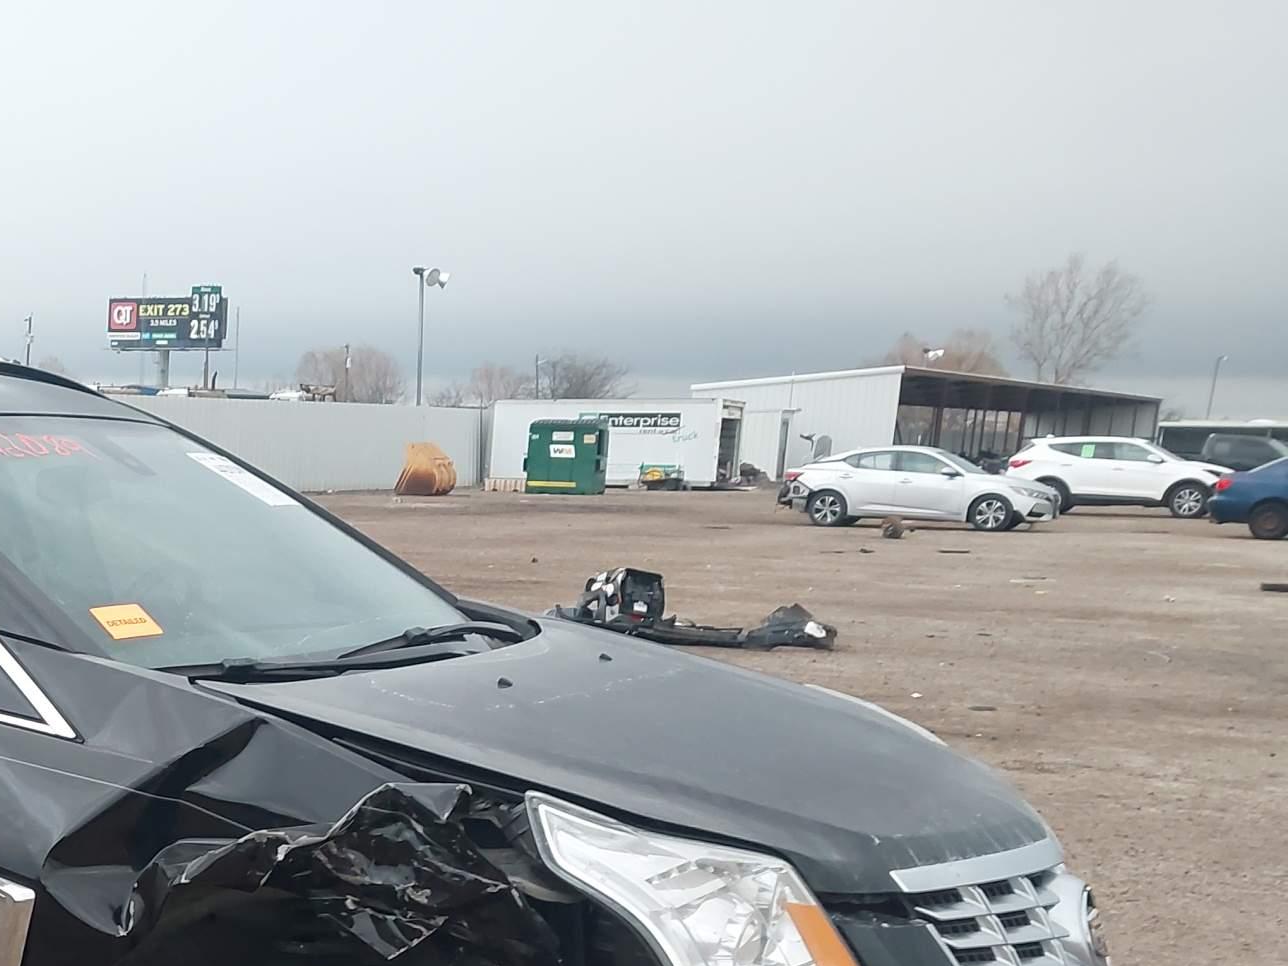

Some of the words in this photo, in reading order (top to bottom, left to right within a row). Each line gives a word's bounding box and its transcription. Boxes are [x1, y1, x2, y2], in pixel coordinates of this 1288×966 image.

[113, 305, 132, 325] QT
[139, 304, 165, 316] EXIT
[167, 304, 190, 316] 273
[106, 617, 147, 627] DETAILED
